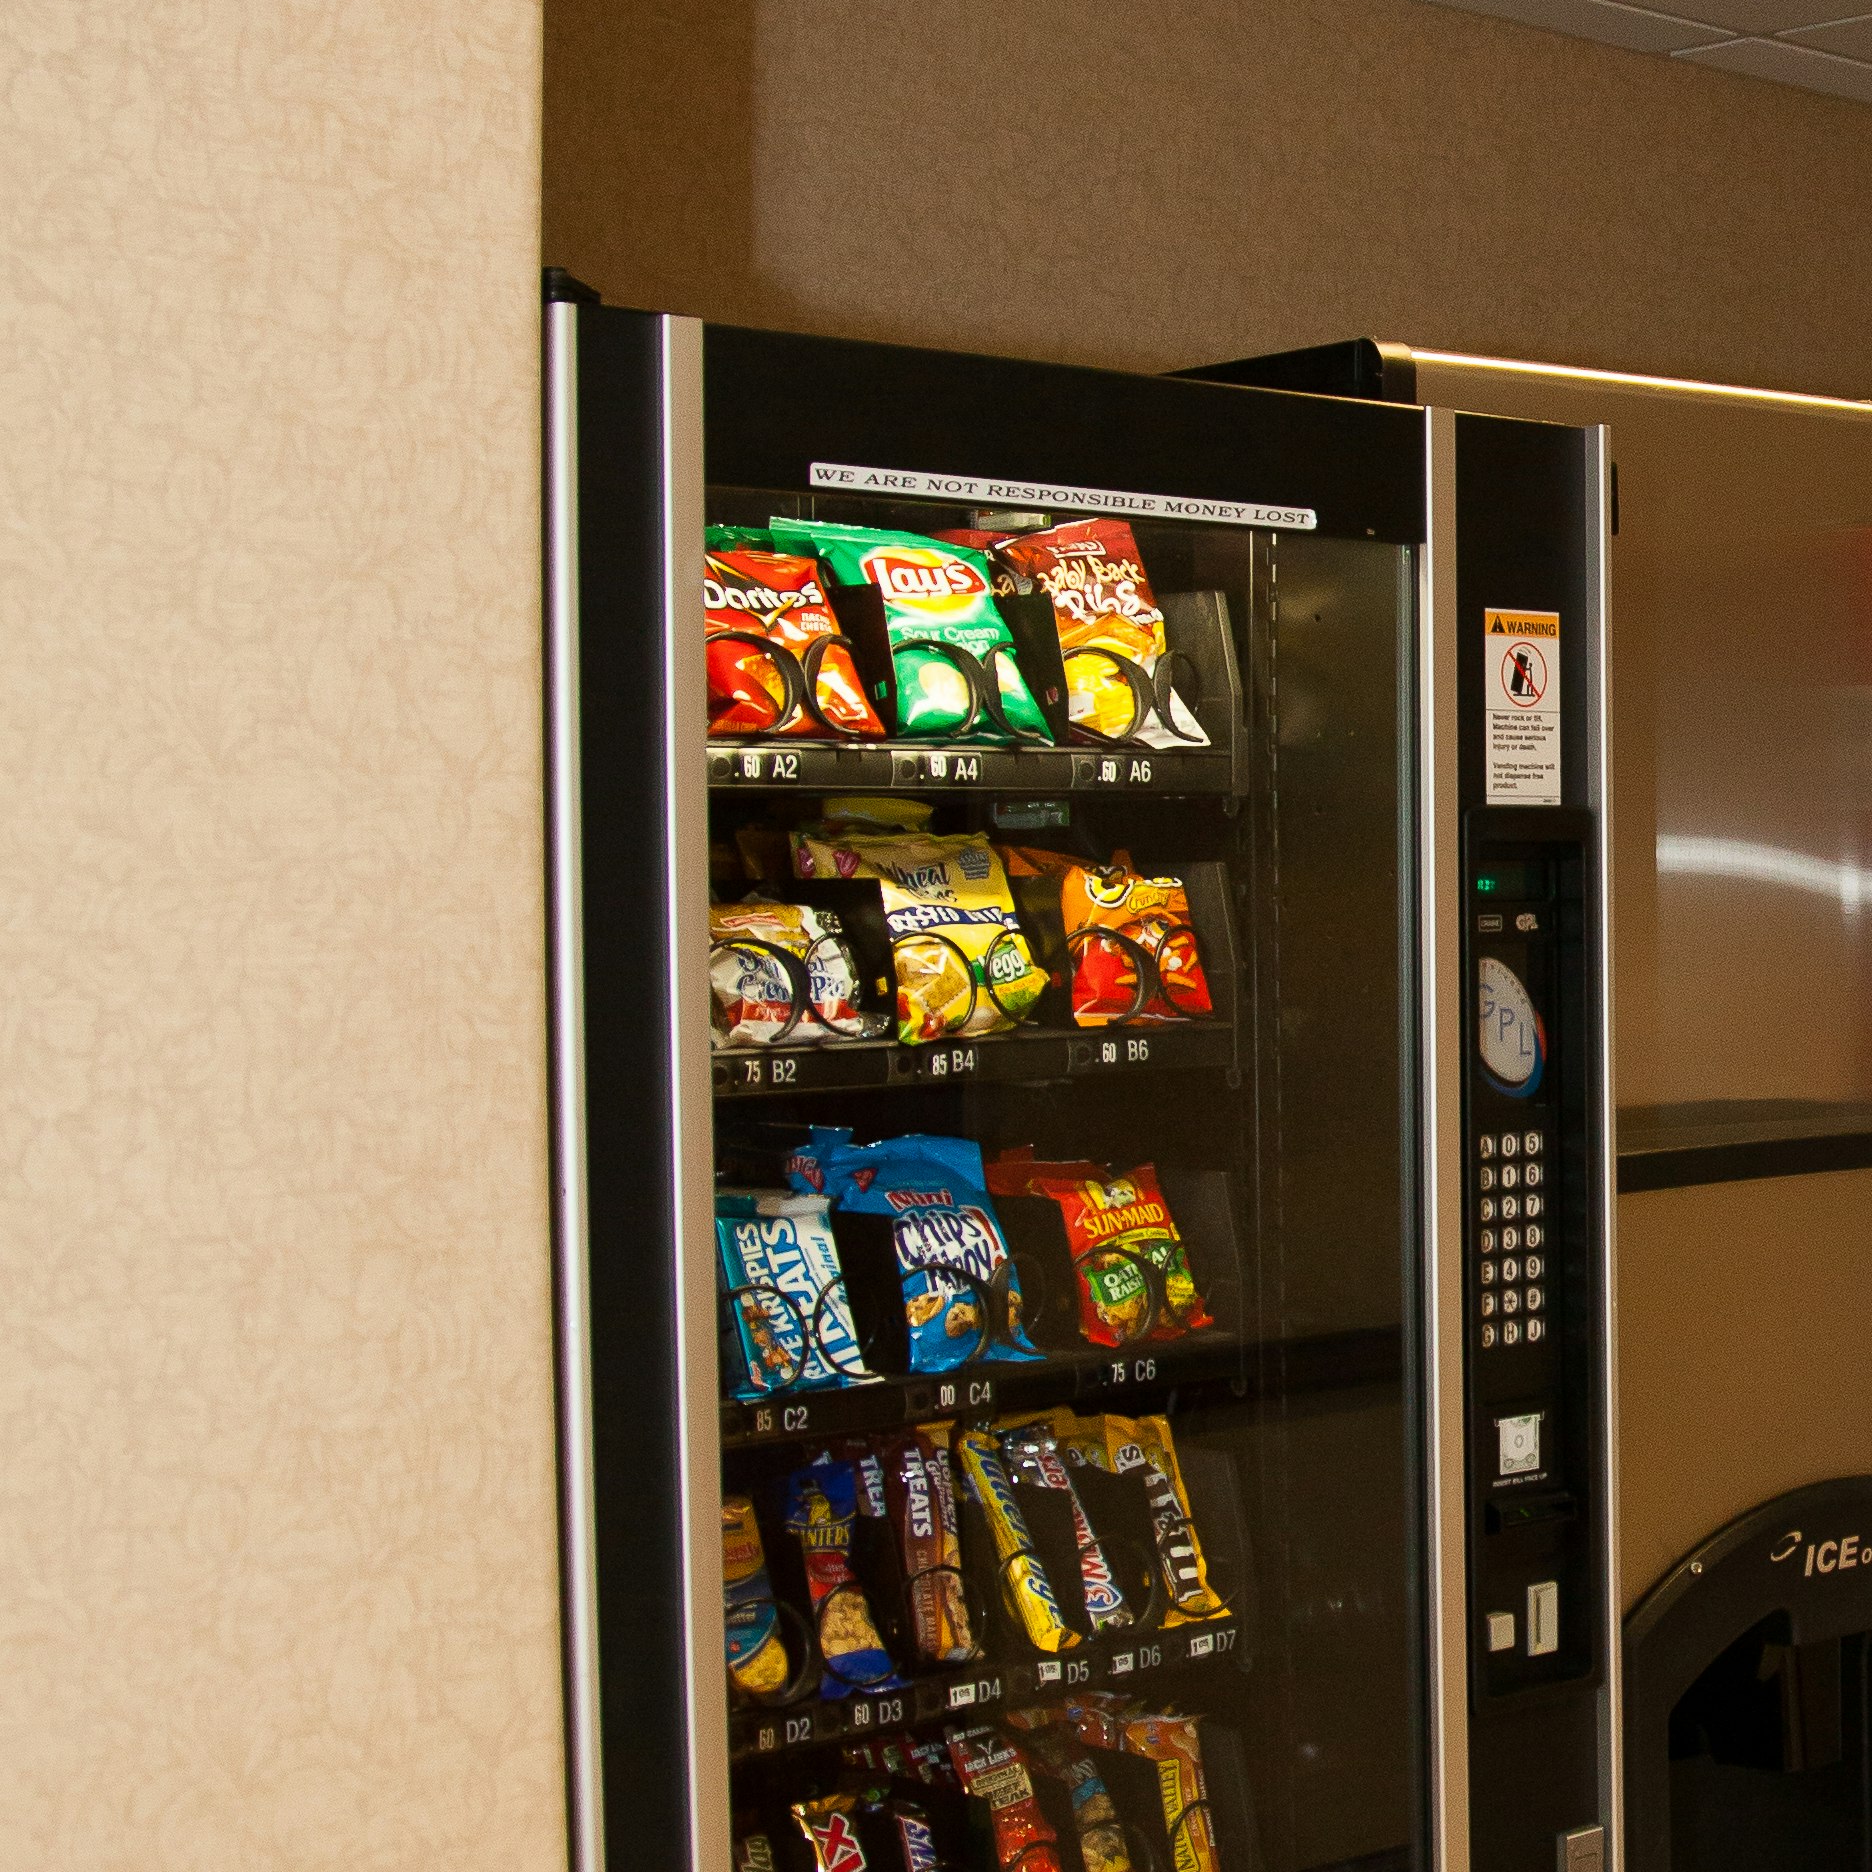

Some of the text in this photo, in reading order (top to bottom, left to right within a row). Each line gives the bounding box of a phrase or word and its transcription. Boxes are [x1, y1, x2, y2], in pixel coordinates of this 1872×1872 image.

[814, 468, 1310, 525] WE ARE NOT RESPONSIBLE MONEY LOST
[872, 558, 973, 600] Lay's
[1088, 556, 1146, 584] Back
[703, 578, 824, 610] Doritos
[944, 627, 1000, 642] Cream
[1506, 620, 1557, 636] WARNING
[773, 754, 798, 778] A2
[955, 757, 978, 780] A4
[1130, 761, 1152, 782] A6
[952, 1049, 975, 1073] B4
[1127, 1039, 1149, 1061] B6
[772, 1058, 797, 1083] B2
[886, 1189, 953, 1211] Mini
[893, 1208, 983, 1269] Chips
[1135, 1359, 1156, 1382] C6
[969, 1381, 992, 1406] C4
[783, 1406, 809, 1432] C2
[903, 1446, 934, 1539] TREATS
[1804, 1535, 1861, 1577] ICE
[1216, 1629, 1236, 1653] D7
[1139, 1646, 1162, 1669] D6
[1067, 1660, 1090, 1684] D5
[978, 1678, 1001, 1703] D4
[879, 1700, 903, 1725] D3
[786, 1716, 811, 1743] D2
